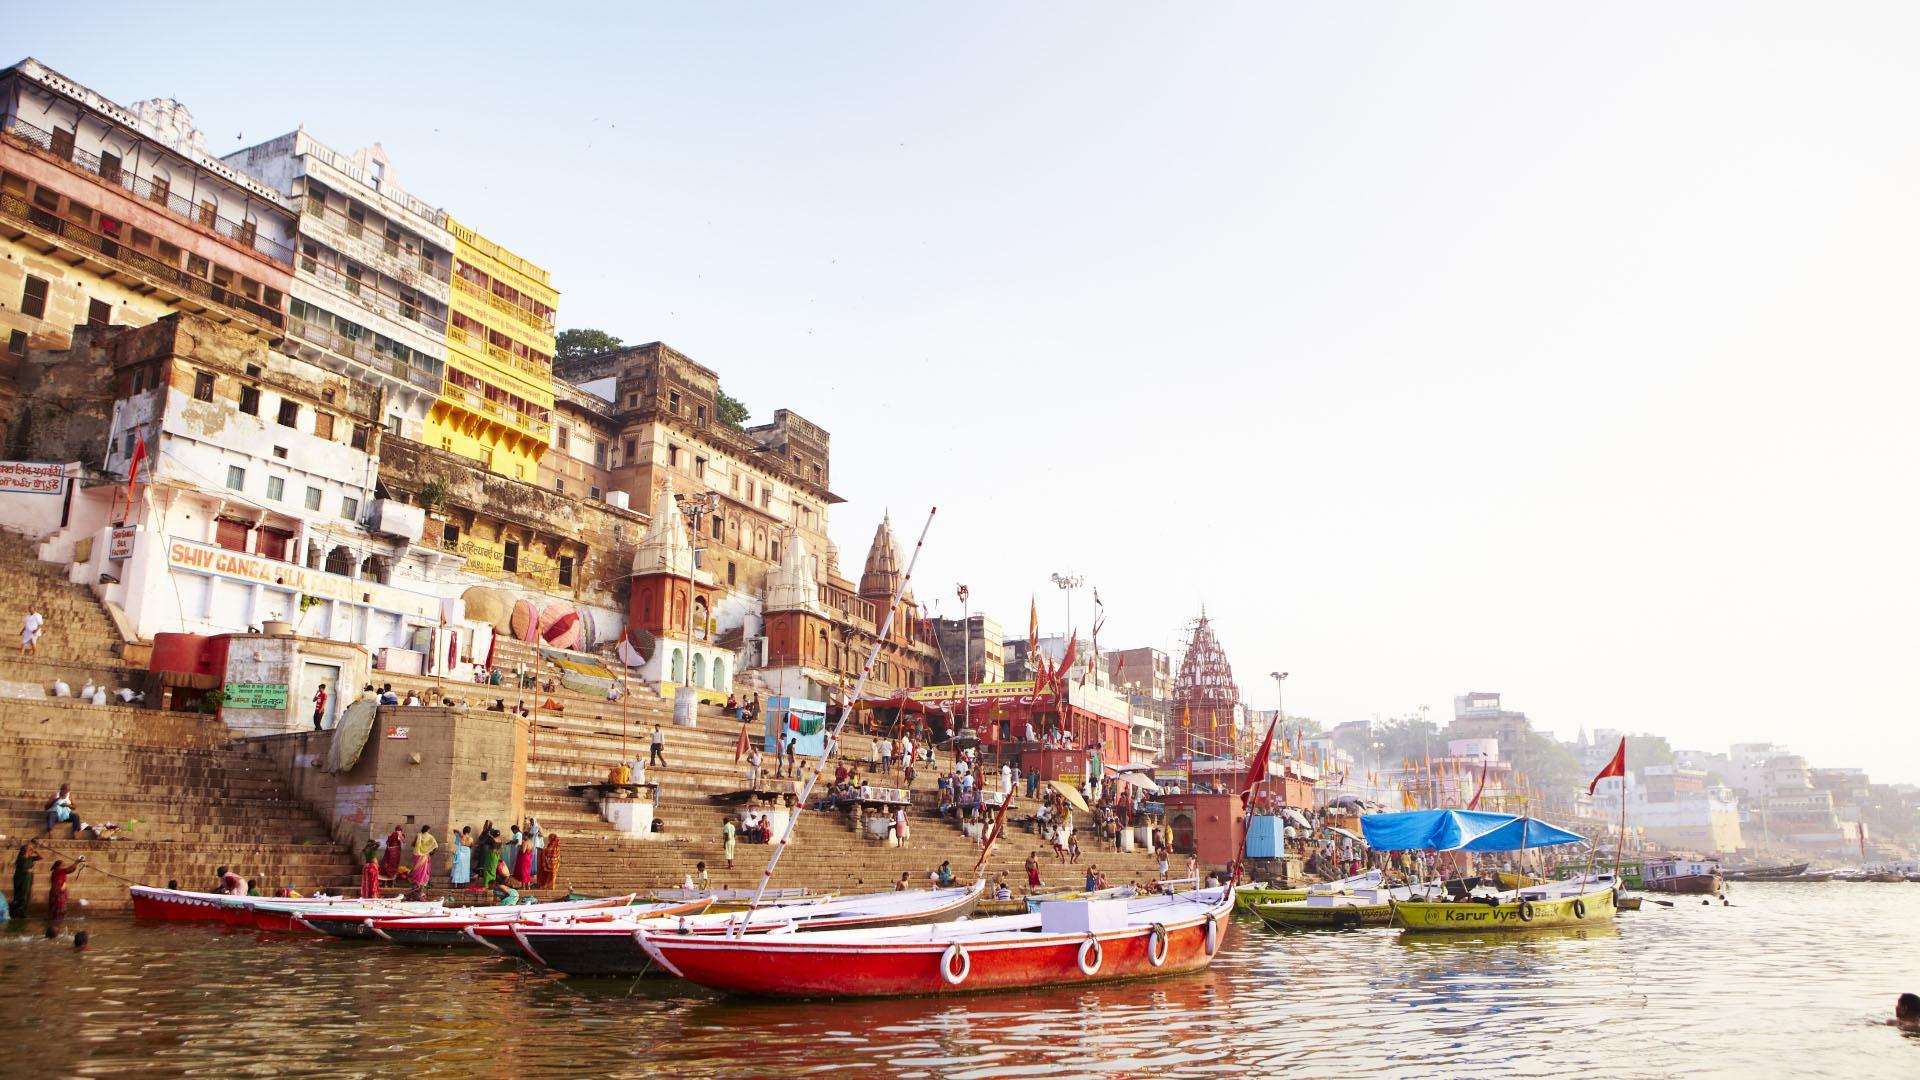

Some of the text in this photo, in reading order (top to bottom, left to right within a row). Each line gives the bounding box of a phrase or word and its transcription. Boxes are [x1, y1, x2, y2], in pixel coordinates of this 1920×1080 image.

[171, 543, 214, 568] SHIV
[215, 553, 271, 579] GANGA
[274, 566, 307, 589] SILK
[1445, 909, 1490, 922] Karur
